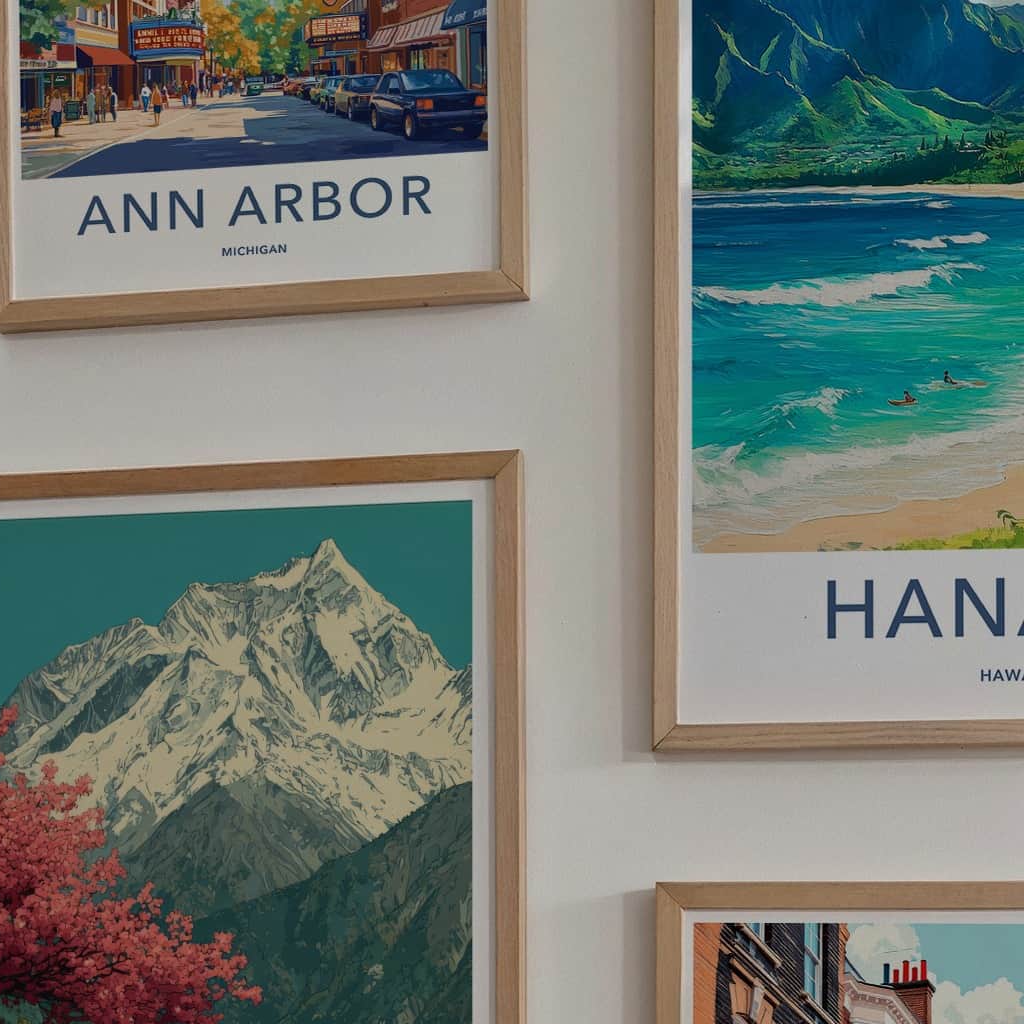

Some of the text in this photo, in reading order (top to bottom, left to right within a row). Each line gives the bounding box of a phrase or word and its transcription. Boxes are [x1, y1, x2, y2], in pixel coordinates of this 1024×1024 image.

[77, 175, 432, 236] ANN ARBOR
[221, 243, 287, 257] MICHIGAN
[826, 577, 1024, 639] HAN
[980, 668, 1024, 682] HAW
